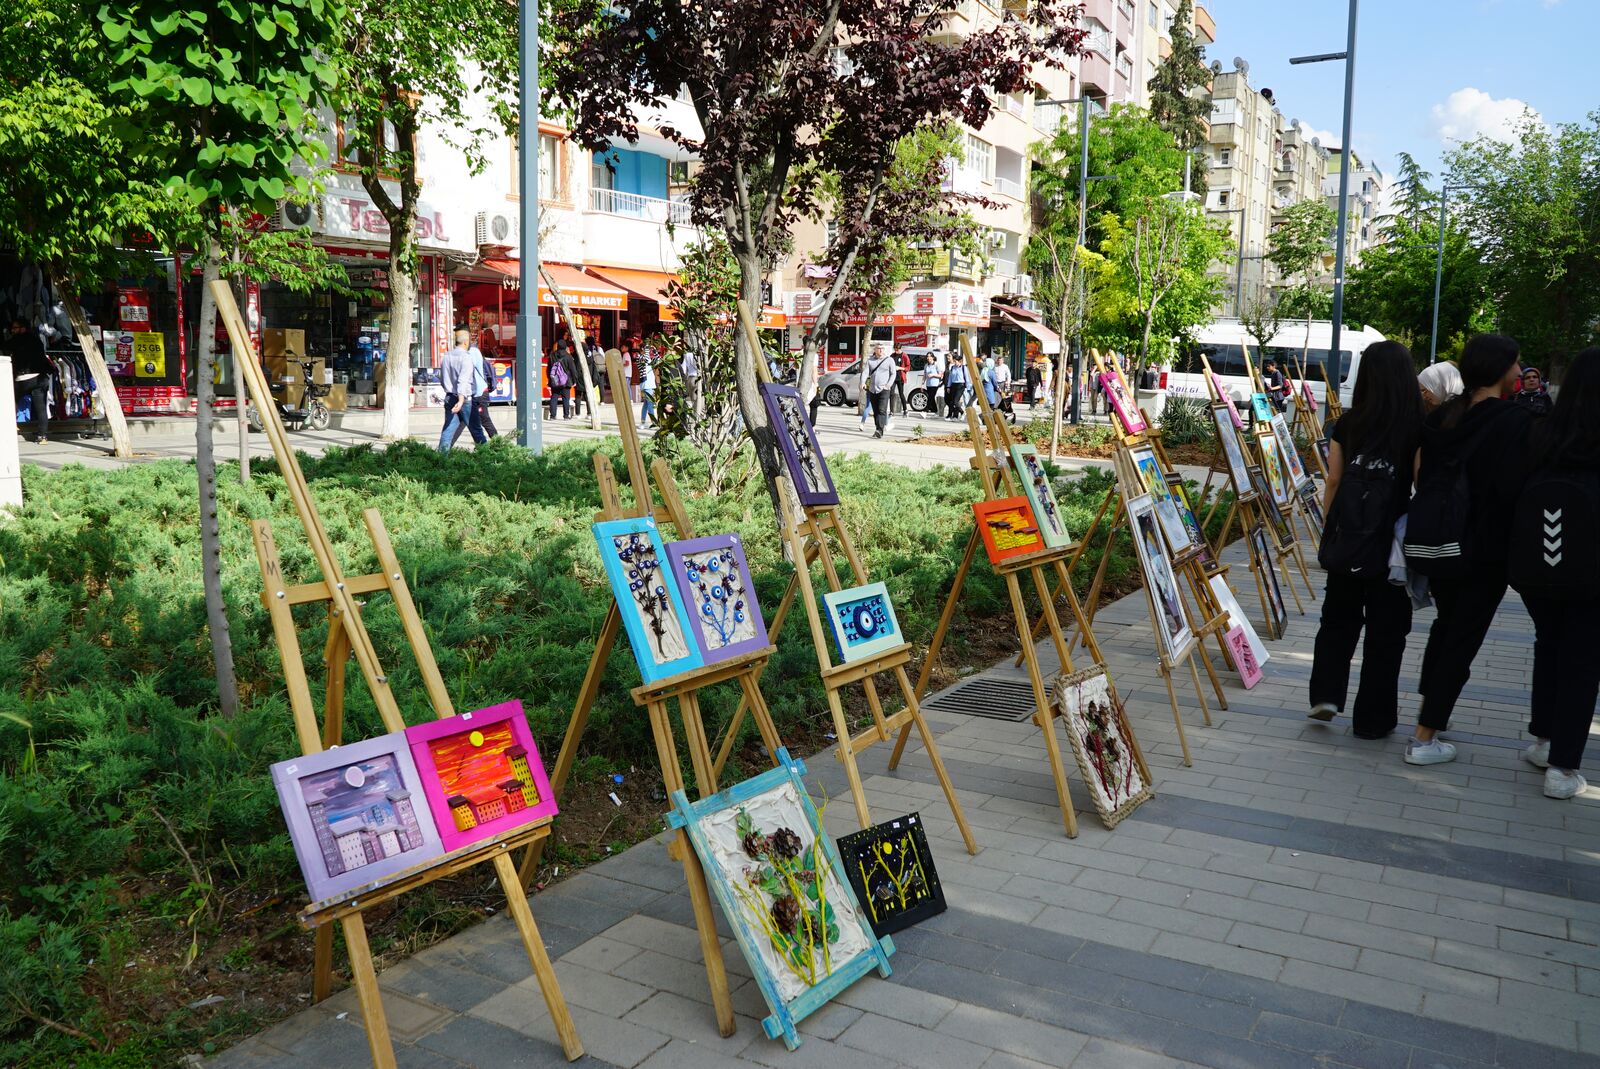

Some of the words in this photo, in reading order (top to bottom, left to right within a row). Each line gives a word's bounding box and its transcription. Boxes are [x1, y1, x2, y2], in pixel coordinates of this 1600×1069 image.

[340, 197, 449, 242] Teal
[581, 295, 623, 307] MARKET
[137, 344, 147, 352] 25
[148, 344, 162, 352] GB
